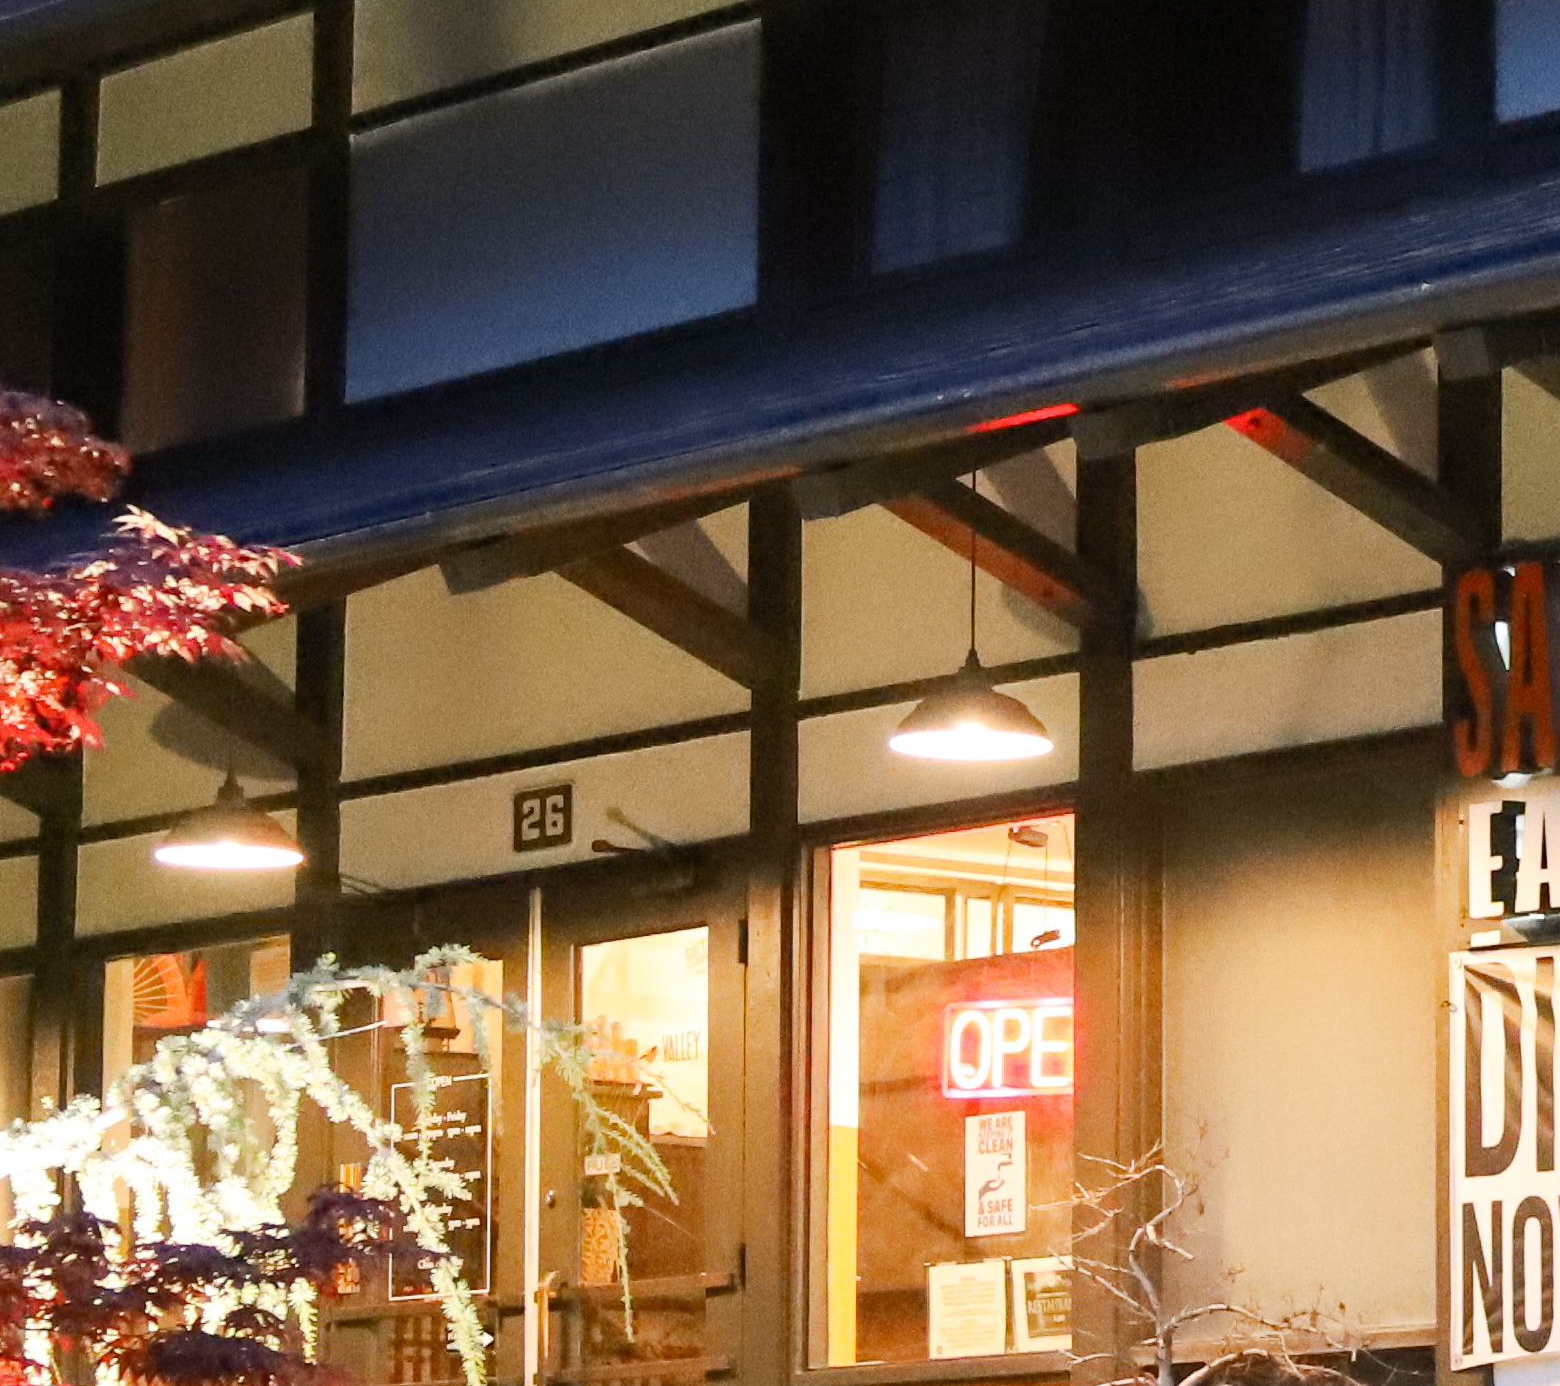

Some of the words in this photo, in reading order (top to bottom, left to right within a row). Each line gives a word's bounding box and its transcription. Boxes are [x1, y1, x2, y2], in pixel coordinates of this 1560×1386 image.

[522, 795, 564, 841] 26
[662, 1030, 700, 1063] VALLEY
[950, 1006, 1074, 1089] OPE
[979, 1118, 992, 1131] WE
[996, 1115, 1012, 1131] ARE
[979, 1138, 1012, 1154] CLEAN
[987, 1198, 1013, 1214] SAFE
[978, 1215, 994, 1228] FOR
[997, 1213, 1013, 1226] ALL
